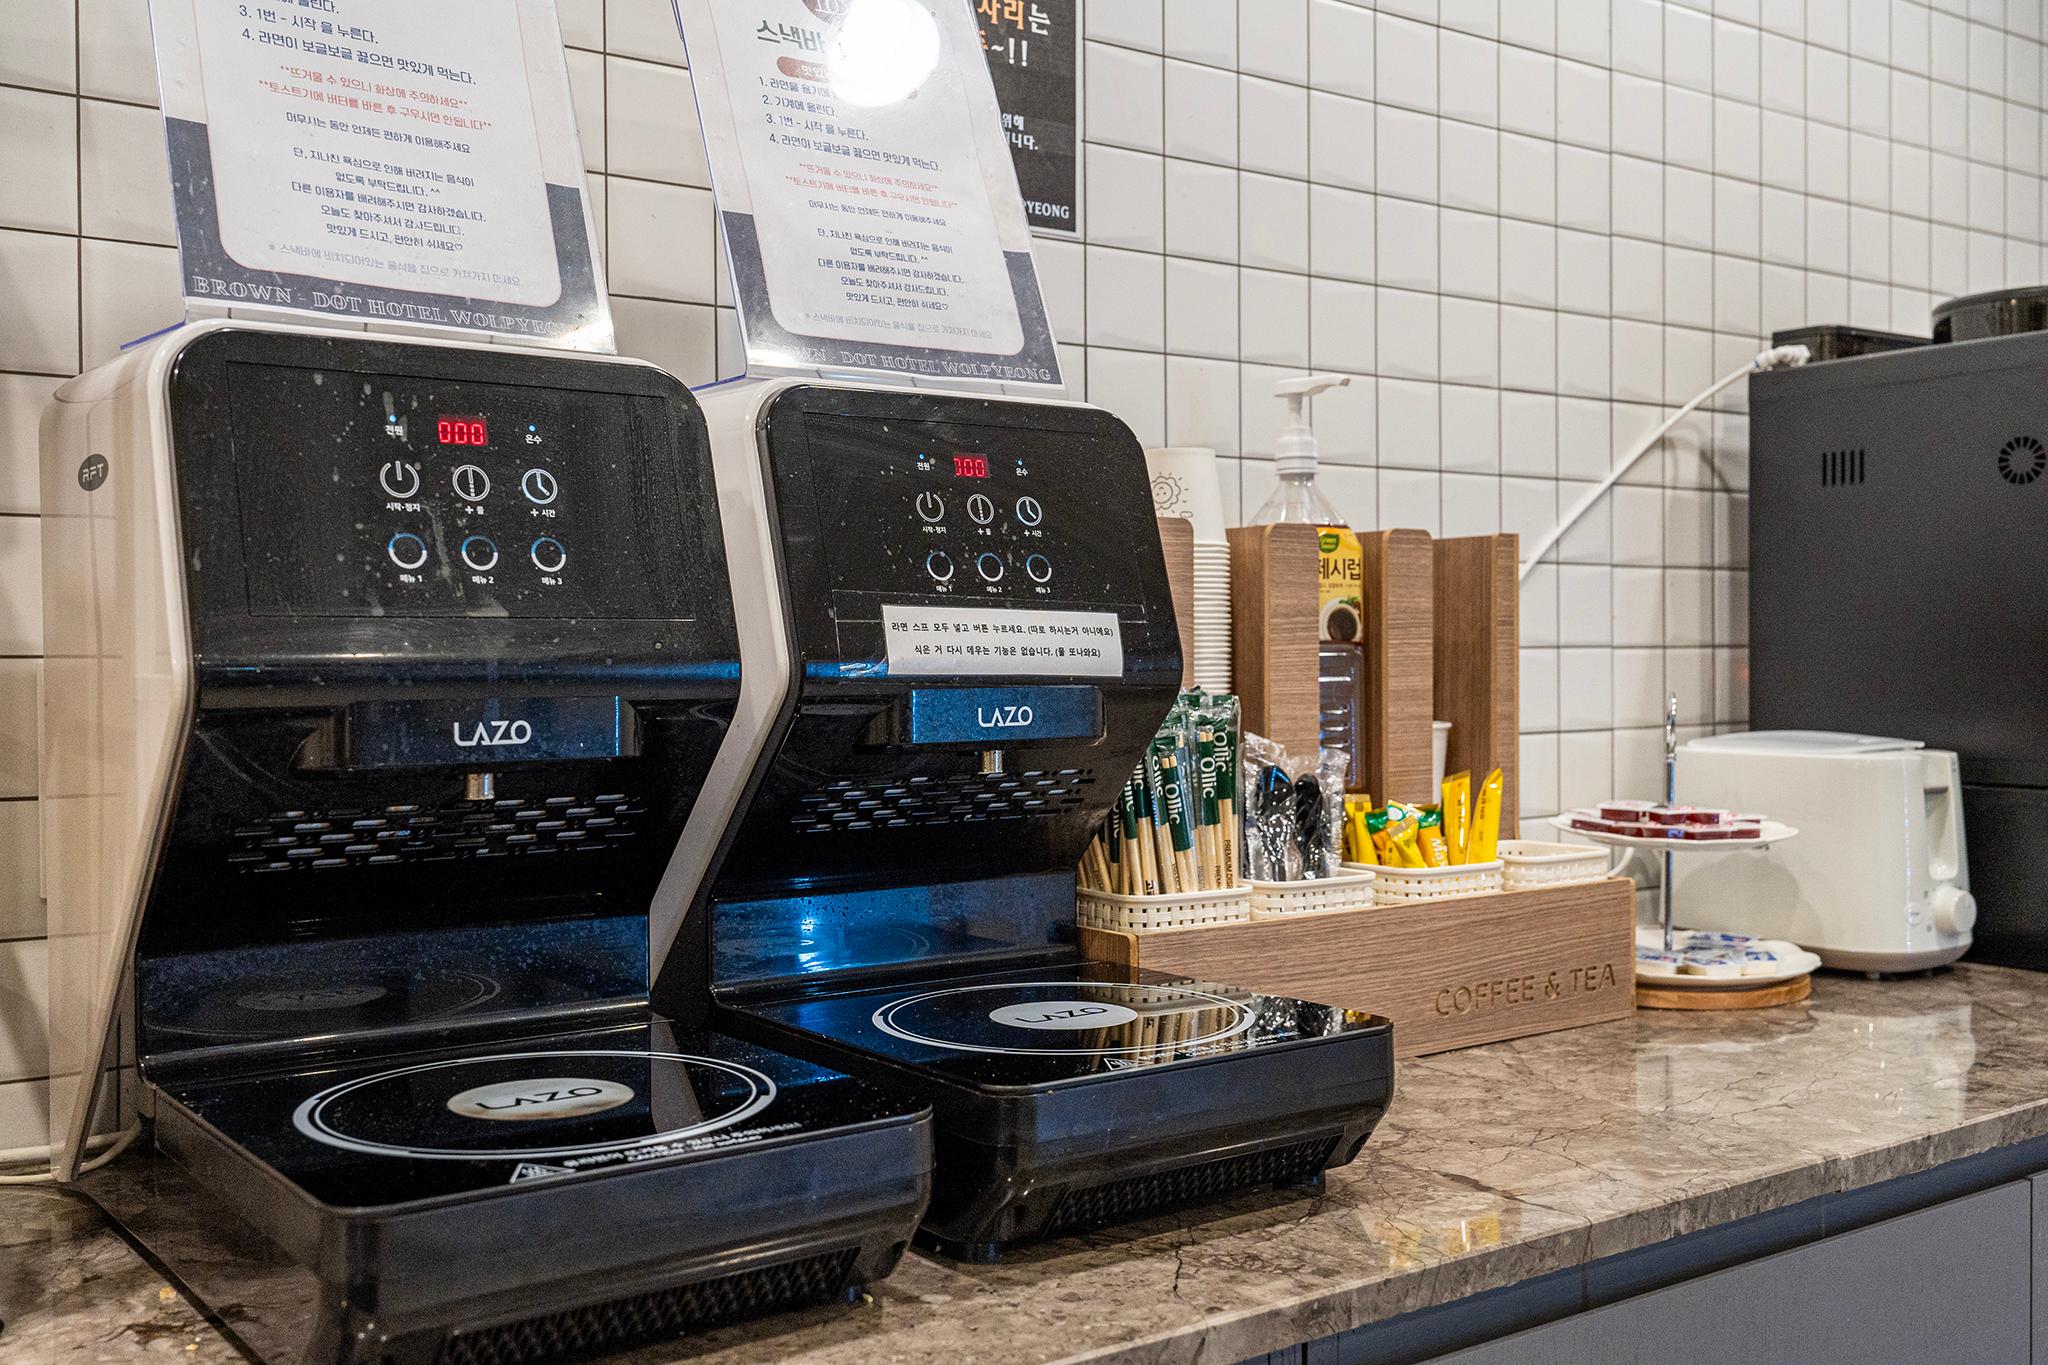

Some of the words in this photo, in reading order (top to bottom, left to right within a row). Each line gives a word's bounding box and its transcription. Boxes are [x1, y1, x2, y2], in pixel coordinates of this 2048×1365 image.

[239, 4, 252, 18] 3.
[256, 8, 276, 23] 1번
[292, 15, 316, 31] 시작
[321, 21, 333, 34] 을
[338, 24, 379, 44] 누른다.
[757, 20, 826, 53] 스낵바
[242, 28, 254, 41] 4.
[259, 31, 298, 49] 라면이
[302, 40, 353, 60] 보글보글
[356, 50, 394, 68] 끓으면
[397, 59, 434, 76] 맛있게
[437, 67, 476, 85] 먹는다.
[327, 75, 337, 85] 수
[340, 77, 372, 92] 있으니
[375, 83, 406, 98] 화상에
[760, 76, 767, 87] 1.
[770, 78, 799, 92] 라면을
[328, 93, 359, 109] 버터를
[362, 99, 383, 113] 바른
[386, 104, 397, 114] 후
[400, 106, 440, 124] 구우시면
[762, 95, 772, 105] 2.
[775, 96, 804, 111] 기계에
[806, 102, 838, 117] 올린다.
[286, 112, 327, 128] 머무시는
[330, 120, 349, 132] 동안
[352, 124, 381, 138] 언제든
[384, 130, 412, 144] 편하게
[415, 136, 471, 154] 이용해주세요
[766, 113, 776, 124] 3.
[779, 116, 793, 127] 1번
[804, 120, 822, 132] 시작
[825, 124, 835, 135] 을
[838, 126, 869, 141] 누른다.
[769, 133, 779, 144] 4.
[782, 134, 810, 149] 라면이
[813, 140, 850, 156] 보글보글
[852, 146, 881, 161] 끓으면
[883, 152, 911, 166] 맛있게
[912, 158, 942, 172] 먹는다.
[1006, 132, 1038, 150] 니다.
[310, 150, 340, 164] 지나친
[343, 156, 381, 171] 욕심으로
[384, 164, 403, 176] 인해
[406, 168, 444, 182] 버려지는
[446, 174, 474, 187] 음식이
[336, 172, 365, 186] 없도록
[368, 177, 428, 196] 부탁드립니다.
[292, 181, 312, 194] 다른
[315, 186, 354, 201] 이용자를
[357, 193, 414, 211] 배려해주시면
[418, 203, 486, 222] 감사하겠습니다.
[321, 204, 351, 217] 오늘도
[354, 210, 402, 227] 찾아주셔서
[404, 218, 464, 235] 감사드립니다.
[326, 223, 357, 237] 맛있게
[359, 230, 392, 244] 드시고,
[395, 235, 423, 247] 편안히
[818, 258, 834, 268] 다른
[836, 260, 865, 272] 이용자를
[867, 264, 911, 277] 배려해주시면
[841, 276, 864, 286] 오늘도
[866, 279, 902, 291] 찾아주셔서
[904, 283, 949, 296] 감사드립니다.
[192, 275, 292, 304] BROWN
[312, 291, 362, 312] DOT
[367, 299, 447, 322] HOTEL
[846, 292, 869, 302] 맛있게
[870, 295, 895, 306] 드시고,
[897, 298, 919, 308] 편안히
[840, 351, 877, 366] DOT
[881, 356, 940, 372] HOTEL
[941, 361, 1051, 381] WOLPYEONG
[438, 422, 484, 444] 000
[525, 434, 542, 444] 온수
[542, 509, 556, 518] 시간
[400, 574, 417, 583] 메뉴
[472, 576, 487, 584] 메뉴
[542, 577, 557, 586] 메뉴
[892, 622, 908, 632] 라면
[913, 623, 929, 631] 스프
[934, 623, 949, 632] 모두
[953, 623, 969, 632] 넣고
[973, 624, 989, 633] 버튼
[993, 624, 1026, 634] 누르세요.
[1028, 626, 1046, 635] (따로
[1049, 626, 1079, 635] 하시는거
[914, 645, 930, 654] 식은
[935, 645, 942, 654] 거
[947, 646, 963, 654] 다시
[967, 646, 990, 655] 데우는
[994, 646, 1016, 656] 기능은
[1021, 646, 1053, 656] 없습니다.
[1055, 648, 1065, 657] (물
[1069, 648, 1100, 658] 또나와요)
[978, 706, 1033, 728] LAZO
[454, 720, 532, 746] LAZO
[1213, 732, 1232, 773] Ollic
[1152, 755, 1163, 797] Ollic
[1201, 757, 1216, 798] Ollic
[1165, 783, 1183, 825] Ollic
[1224, 840, 1233, 872] PREMIUM
[1435, 975, 1535, 1016] COFFEE
[1544, 972, 1560, 999] &
[1569, 963, 1616, 992] TEA
[1014, 1007, 1108, 1023] LAZO
[476, 1087, 602, 1110] LAZO
